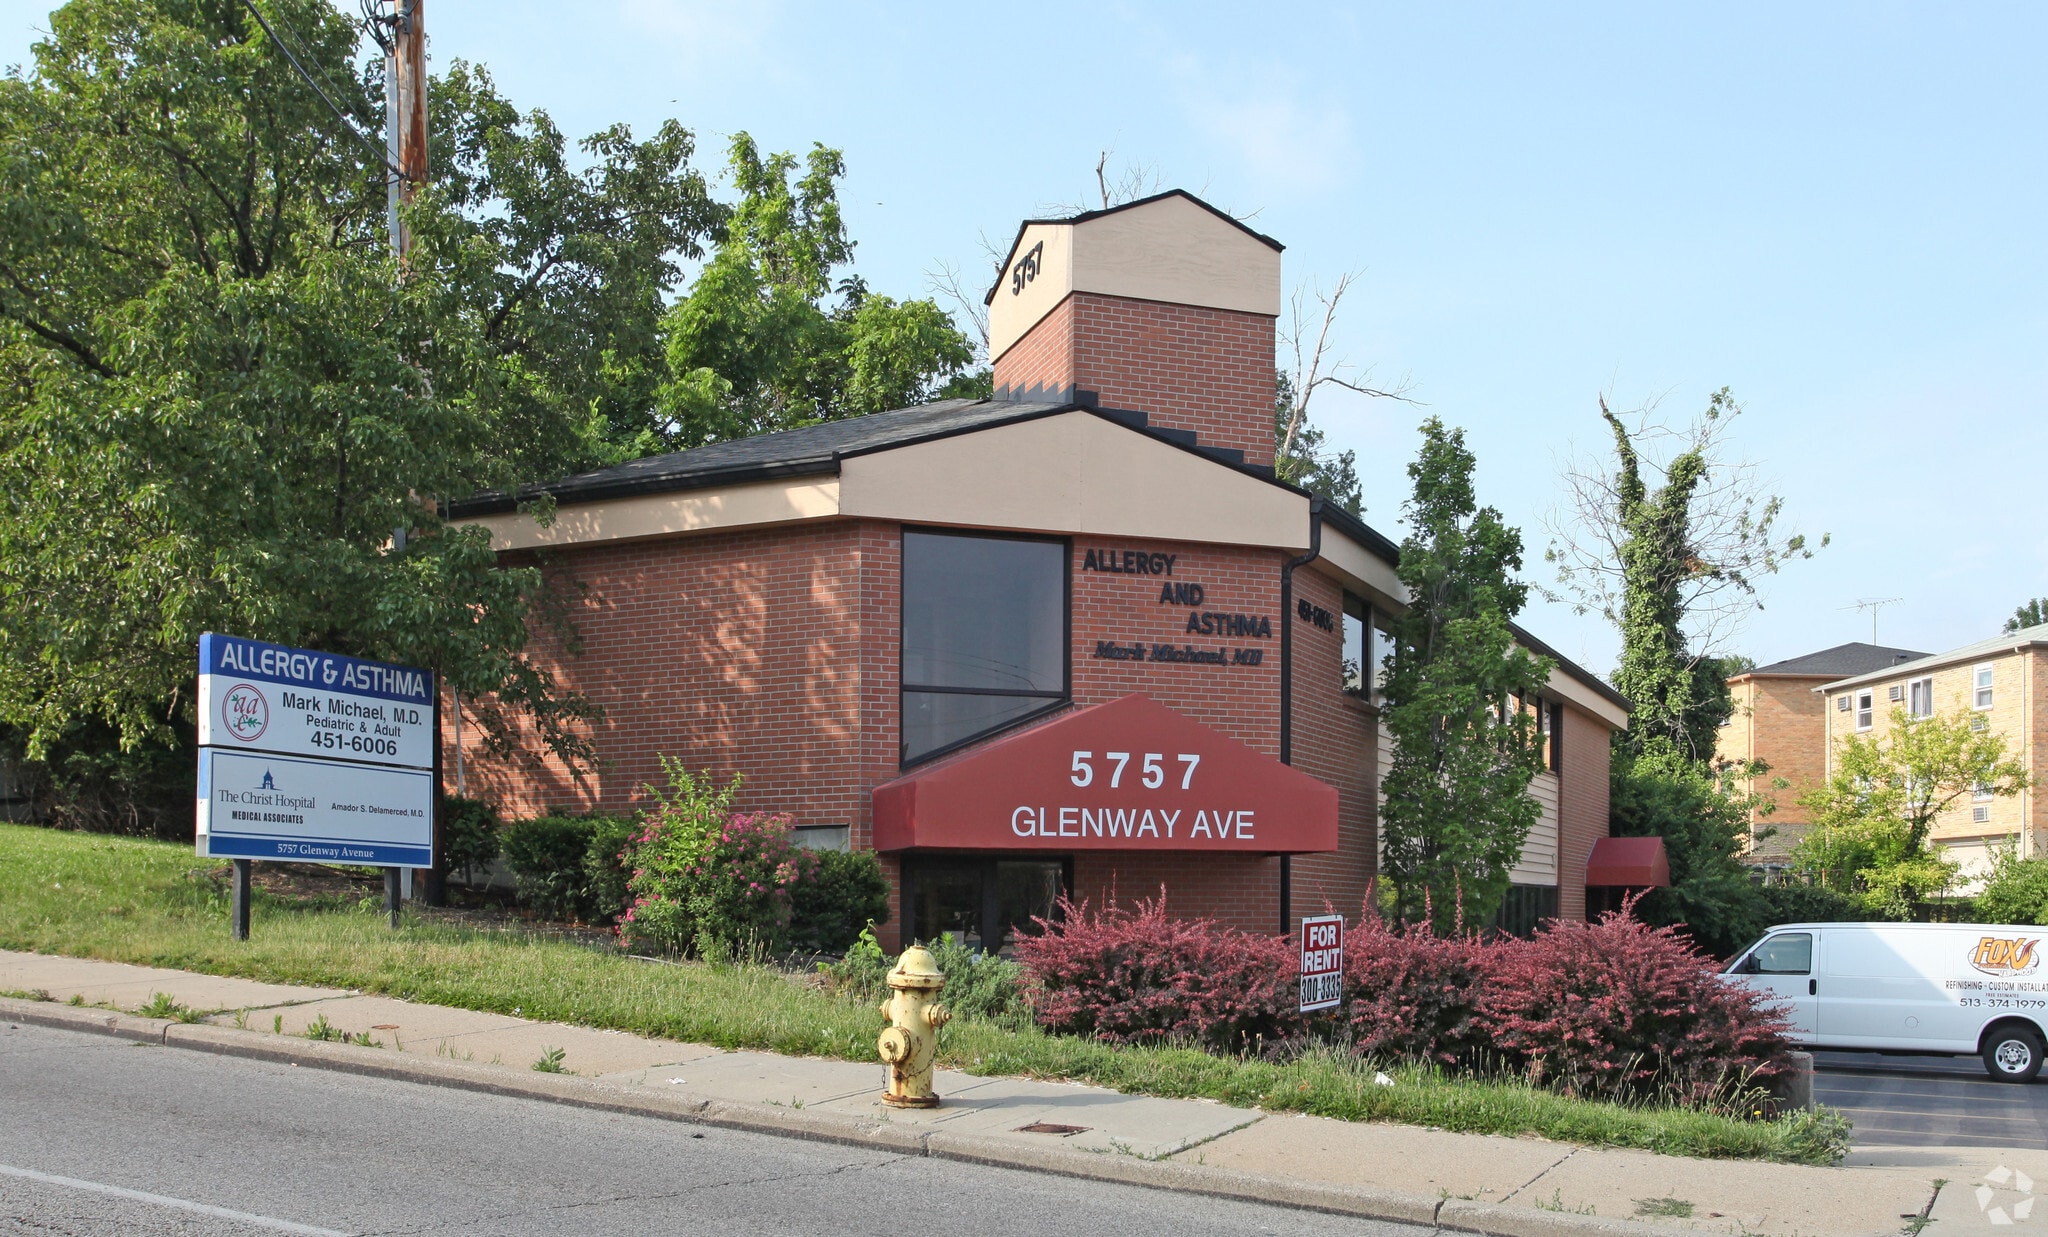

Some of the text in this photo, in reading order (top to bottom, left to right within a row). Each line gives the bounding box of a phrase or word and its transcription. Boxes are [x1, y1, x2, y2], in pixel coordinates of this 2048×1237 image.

[1013, 240, 1043, 296] 5757
[1083, 549, 1176, 575] ALLERGY
[1159, 582, 1204, 606] AND
[1186, 612, 1272, 638] ASTHMA
[1093, 640, 1147, 661] Mark
[1231, 648, 1263, 666] MD
[220, 642, 426, 698] ALLERGY & ASTHMA
[282, 692, 422, 726] Mark Michael, M.D.
[306, 714, 401, 738] Pediatric & Adult
[311, 731, 397, 756] 451-6006
[1071, 751, 1200, 790] 5757
[218, 789, 315, 811] The Christ Hospital
[331, 802, 358, 813] Amador
[360, 804, 367, 813] S.
[410, 808, 425, 818] M.D.
[231, 810, 304, 824] MEDICAL ASSOCIATES
[1010, 806, 1254, 840] GLENWAY AVE
[277, 843, 374, 858] 5757 Glenway Avenue
[1309, 925, 1337, 948] FOR
[1304, 948, 1340, 973] RENT
[1973, 937, 2041, 970] FOX
[1946, 980, 1982, 991] REFINISHING
[1988, 981, 2014, 991] CUSTOM
[1960, 998, 2046, 1009] 513-374-1979
